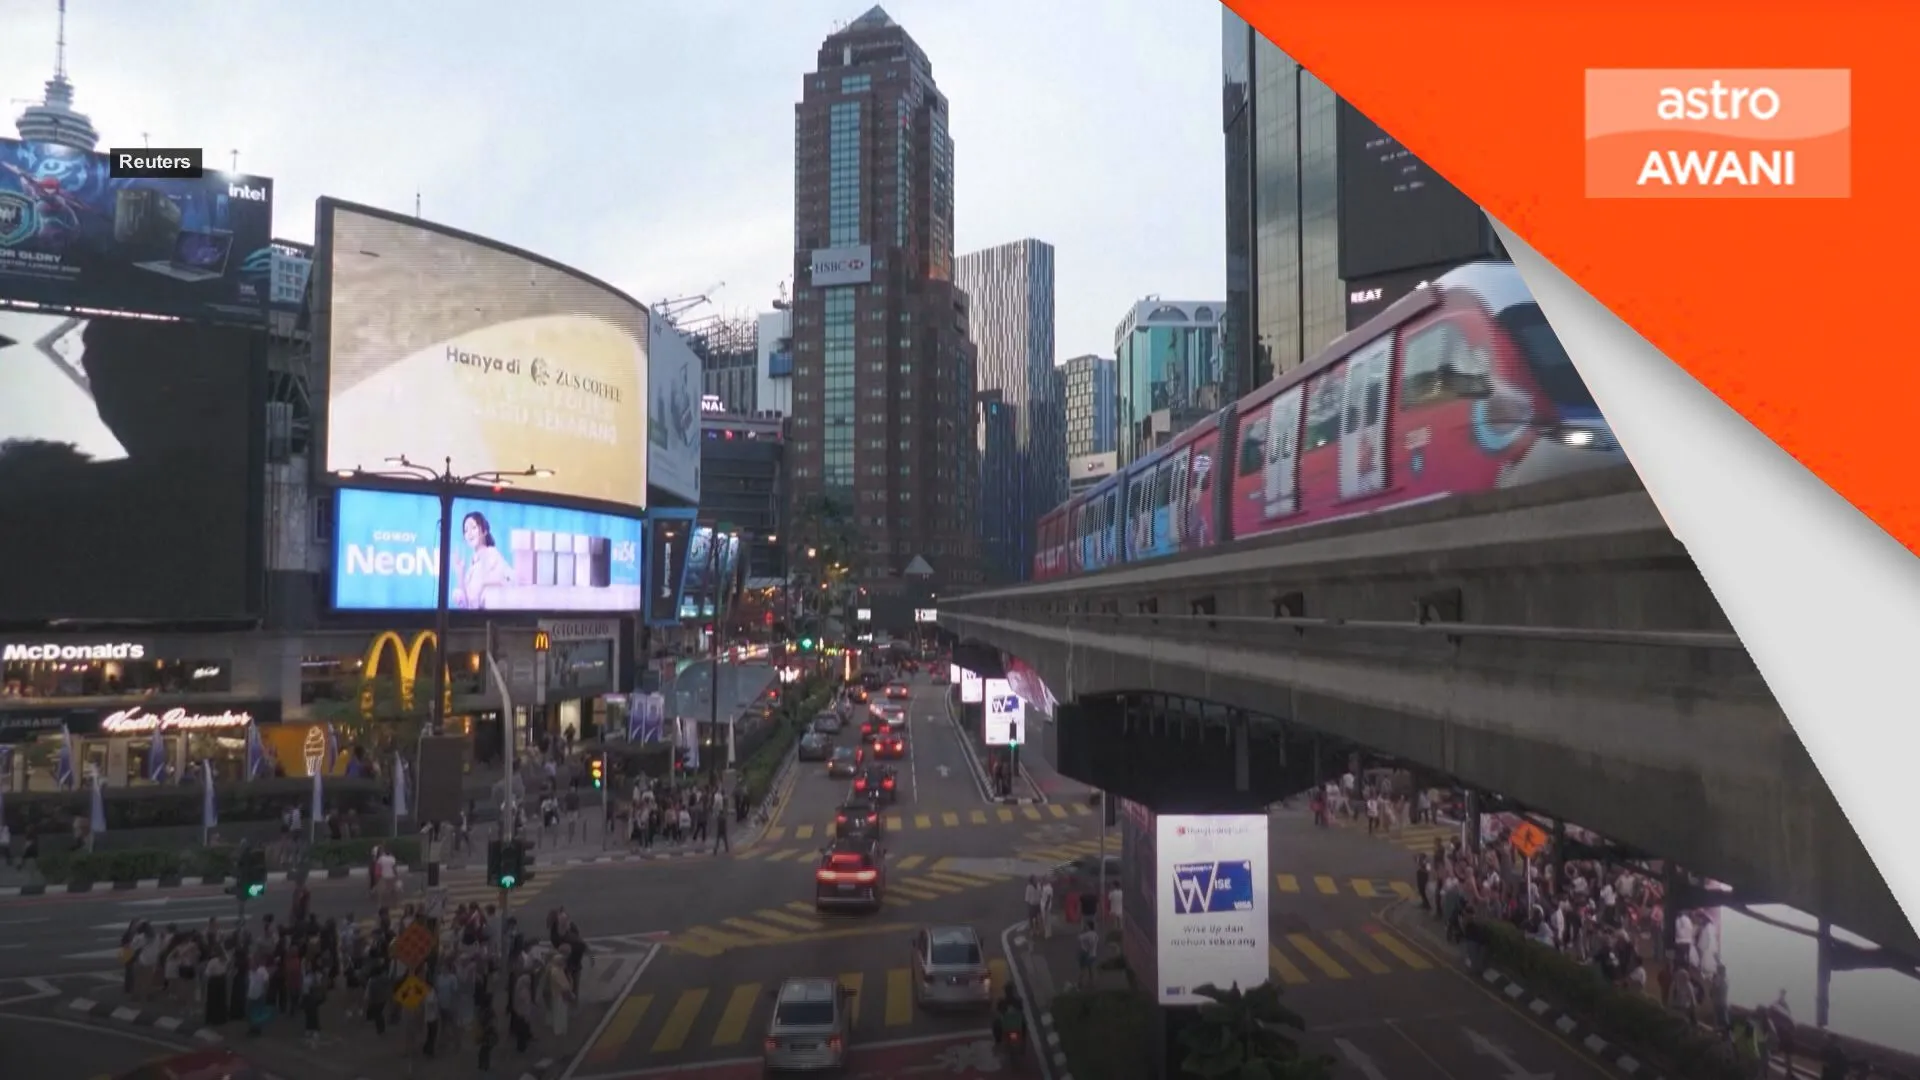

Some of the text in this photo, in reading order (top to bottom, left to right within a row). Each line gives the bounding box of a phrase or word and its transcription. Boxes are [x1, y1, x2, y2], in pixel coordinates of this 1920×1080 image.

[228, 183, 265, 200] intel
[446, 347, 521, 375] Hanya di
[555, 369, 623, 402] ZUS COFFEE
[373, 530, 417, 543] coway
[3, 643, 144, 660] McDonald's
[1184, 924, 1244, 936] Wise Up dan
[1209, 937, 1256, 948] sekarang
